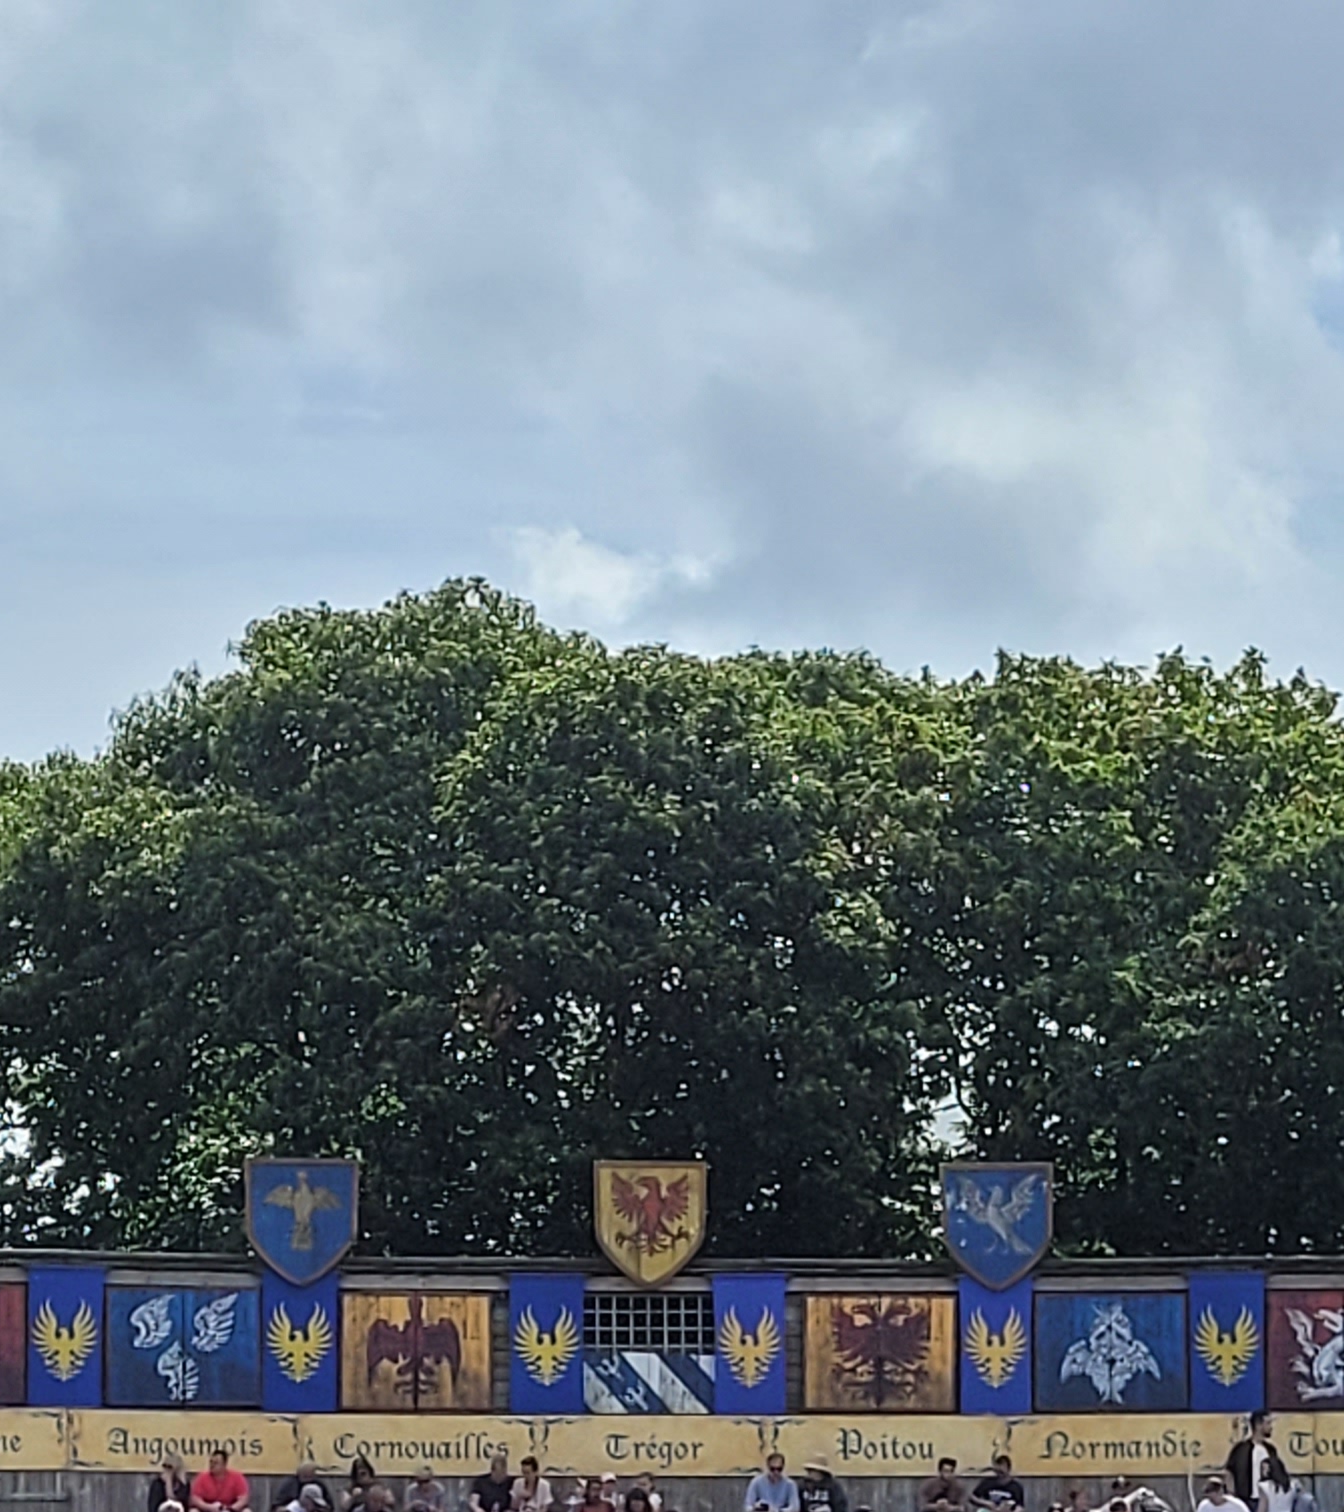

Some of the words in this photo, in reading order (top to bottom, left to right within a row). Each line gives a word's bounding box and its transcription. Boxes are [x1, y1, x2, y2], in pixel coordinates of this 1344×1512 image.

[107, 1426, 264, 1462] Angoumois
[333, 1431, 509, 1460] Cornouailles
[606, 1432, 704, 1468] Trégor
[836, 1427, 934, 1461] Poitou
[1038, 1429, 1202, 1460] Normandie
